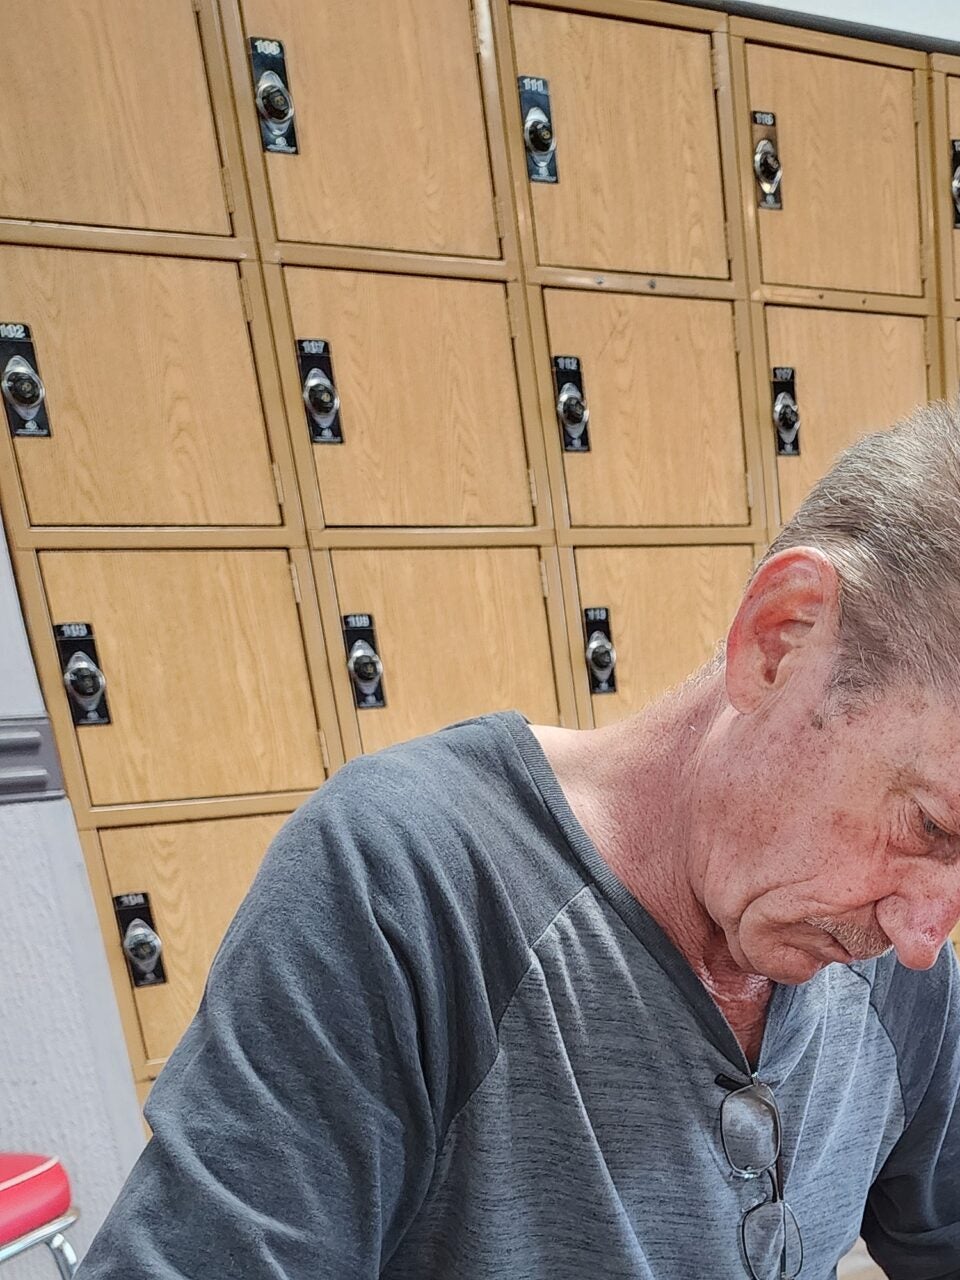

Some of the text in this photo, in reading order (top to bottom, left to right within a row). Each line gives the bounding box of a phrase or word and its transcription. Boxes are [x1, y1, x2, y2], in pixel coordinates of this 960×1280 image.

[254, 40, 281, 54] 106
[523, 77, 544, 91] 111
[0, 325, 26, 338] 102
